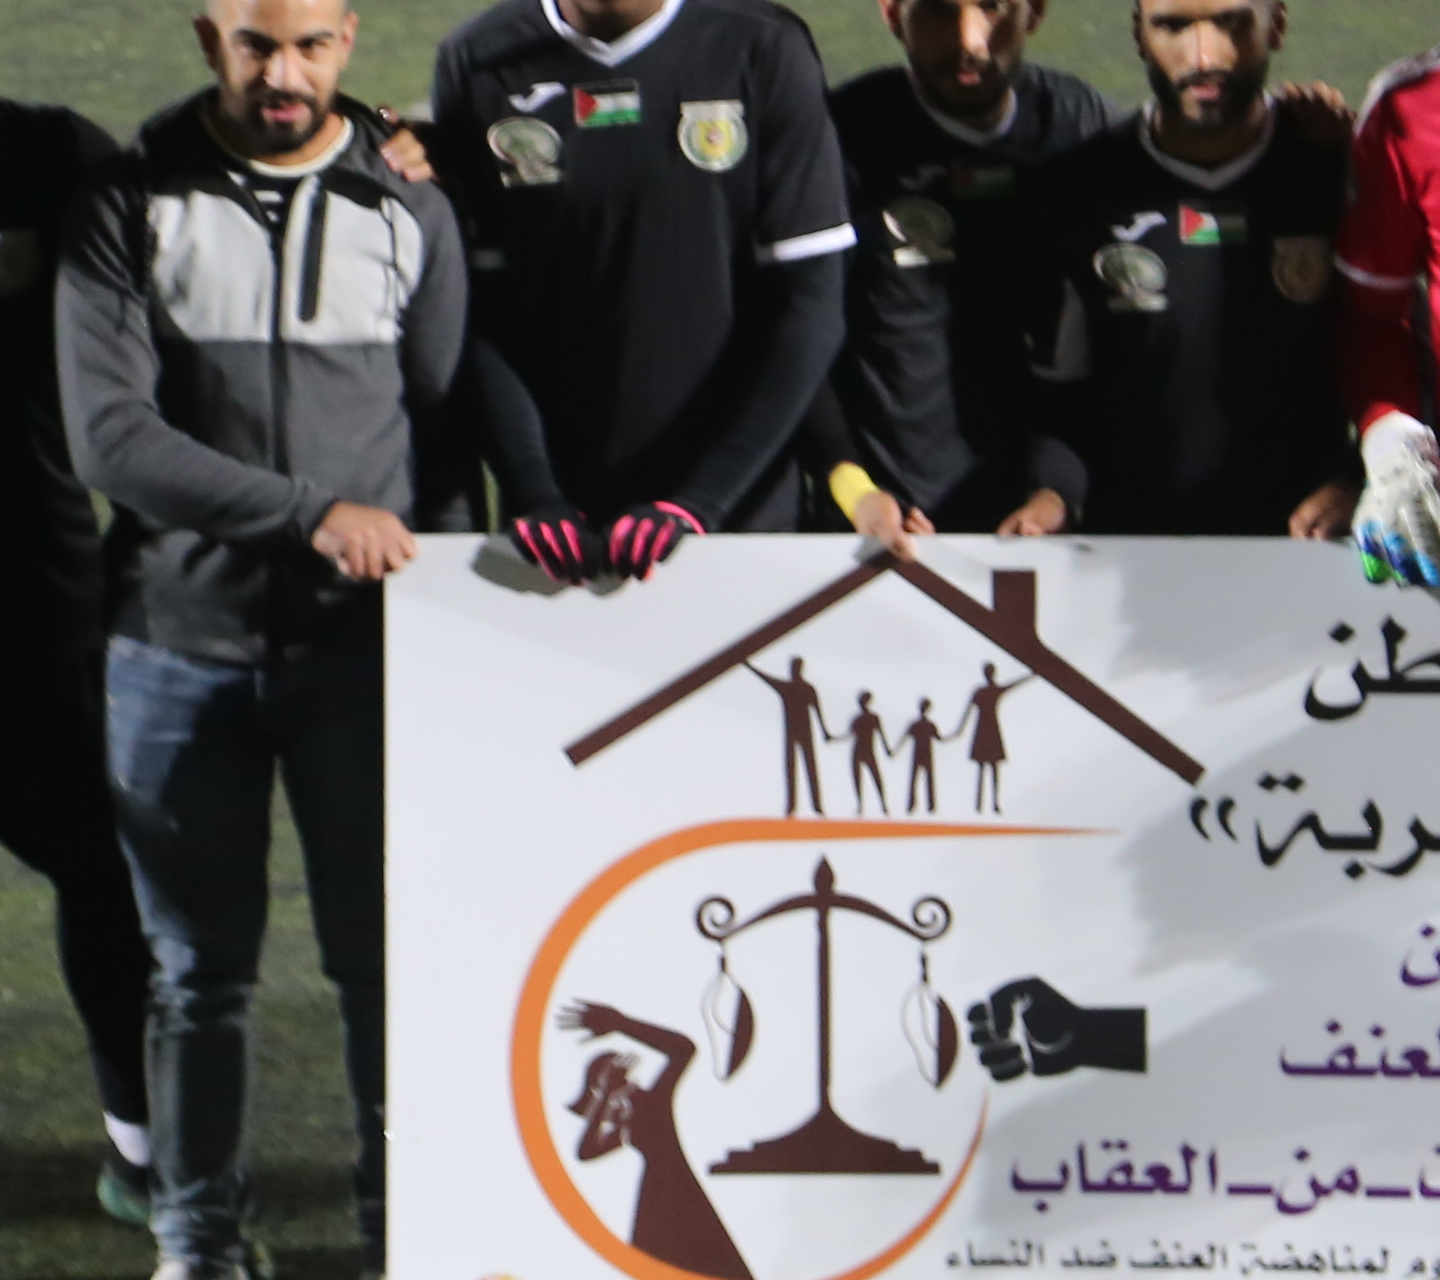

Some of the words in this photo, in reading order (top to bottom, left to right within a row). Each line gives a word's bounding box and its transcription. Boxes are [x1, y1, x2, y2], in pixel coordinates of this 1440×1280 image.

[945, 1238, 1046, 1271] النساء
[1060, 1239, 1119, 1270] ضد
[1128, 1238, 1229, 1271] العنف
